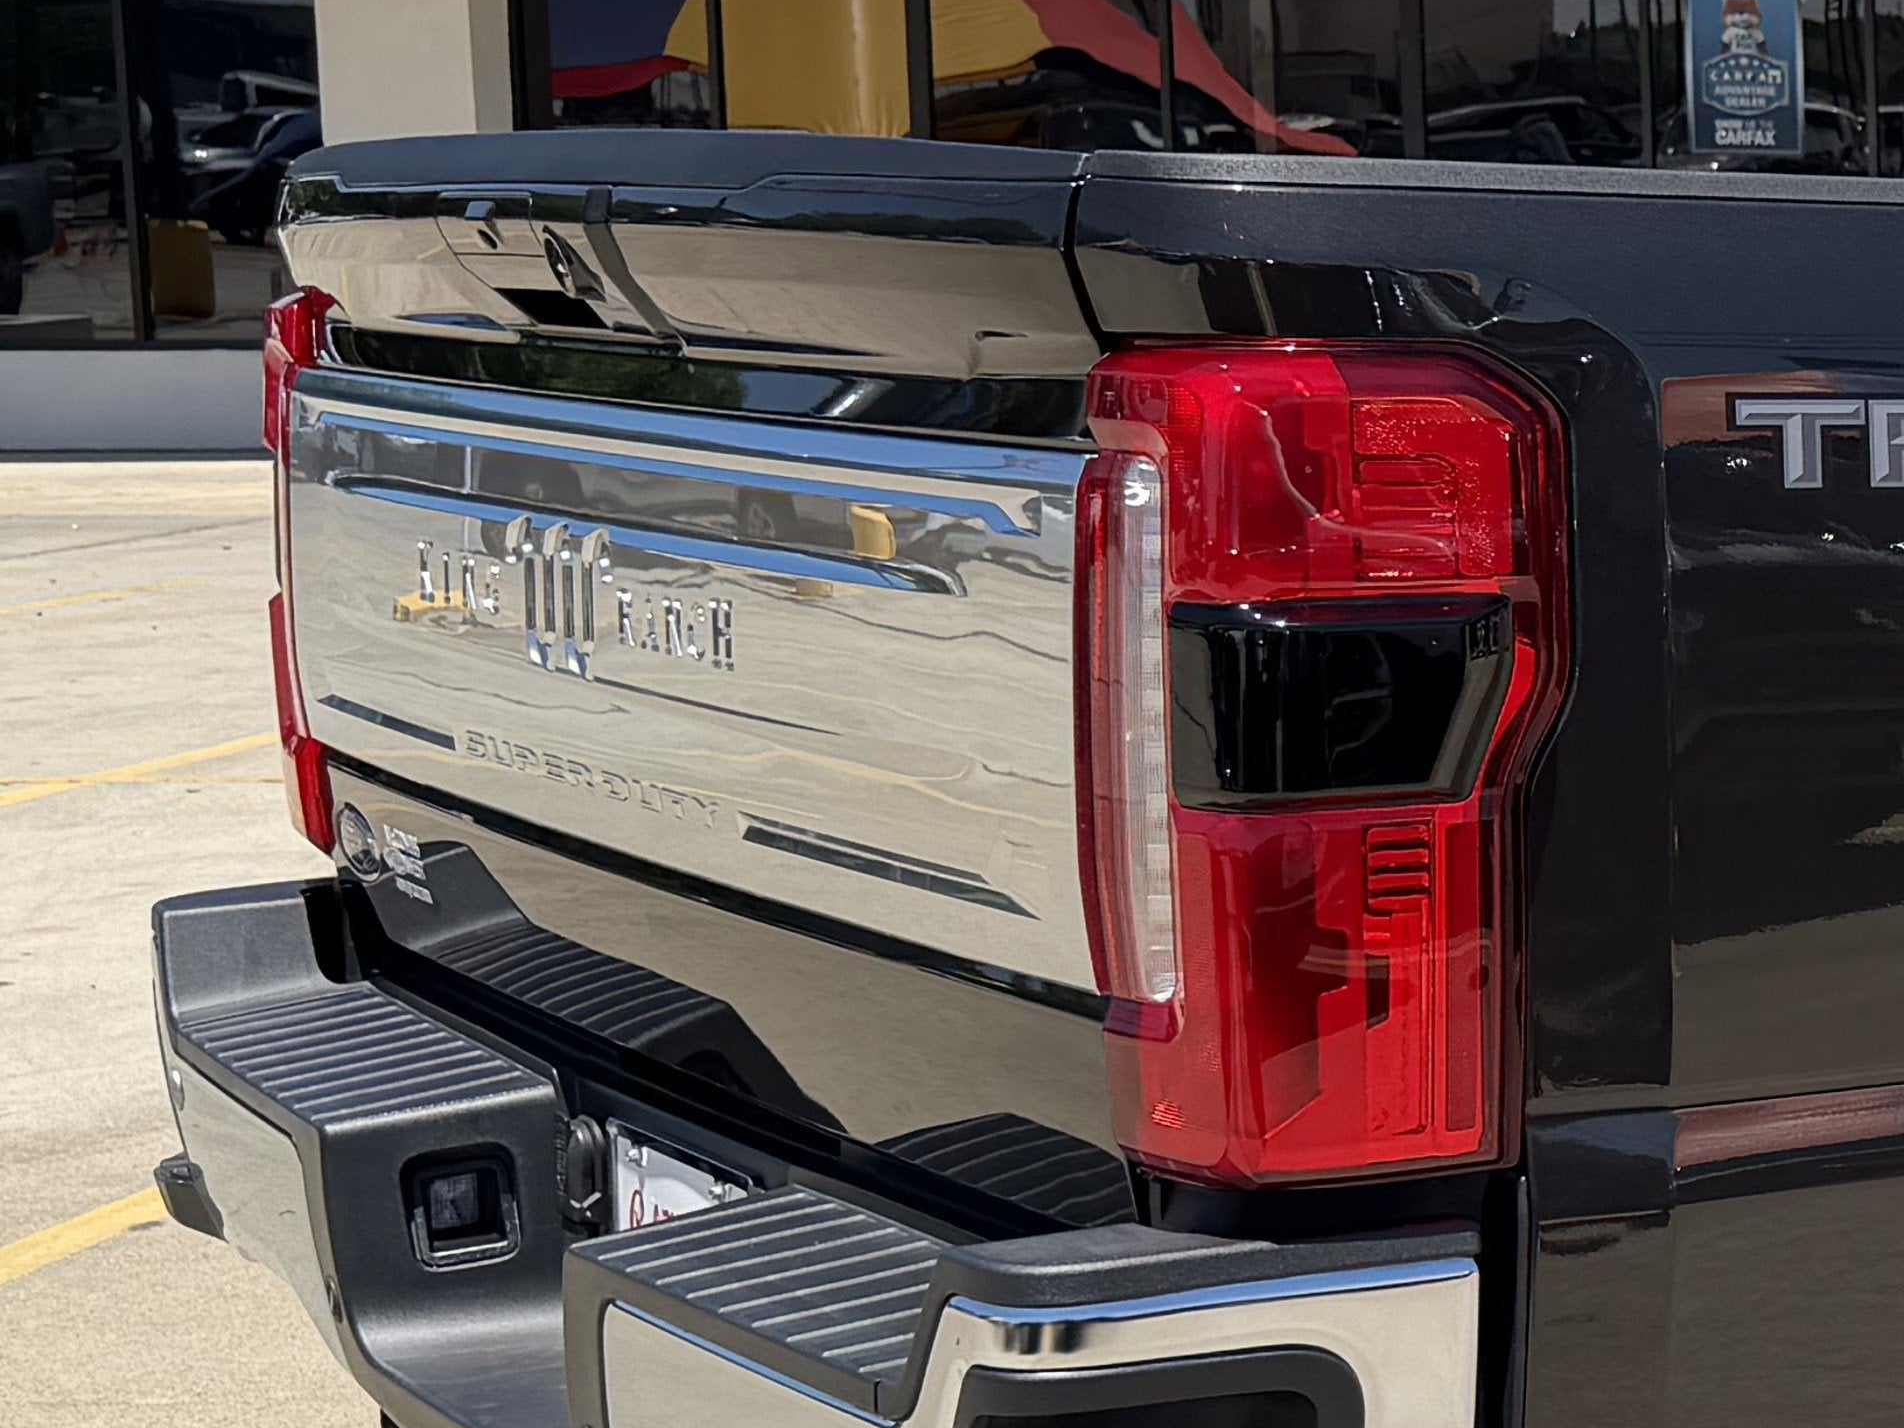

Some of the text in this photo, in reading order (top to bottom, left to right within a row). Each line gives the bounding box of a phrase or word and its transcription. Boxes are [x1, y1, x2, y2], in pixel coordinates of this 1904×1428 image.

[1715, 129, 1776, 146] CARFAX
[465, 729, 720, 830] SUPER DUTY
